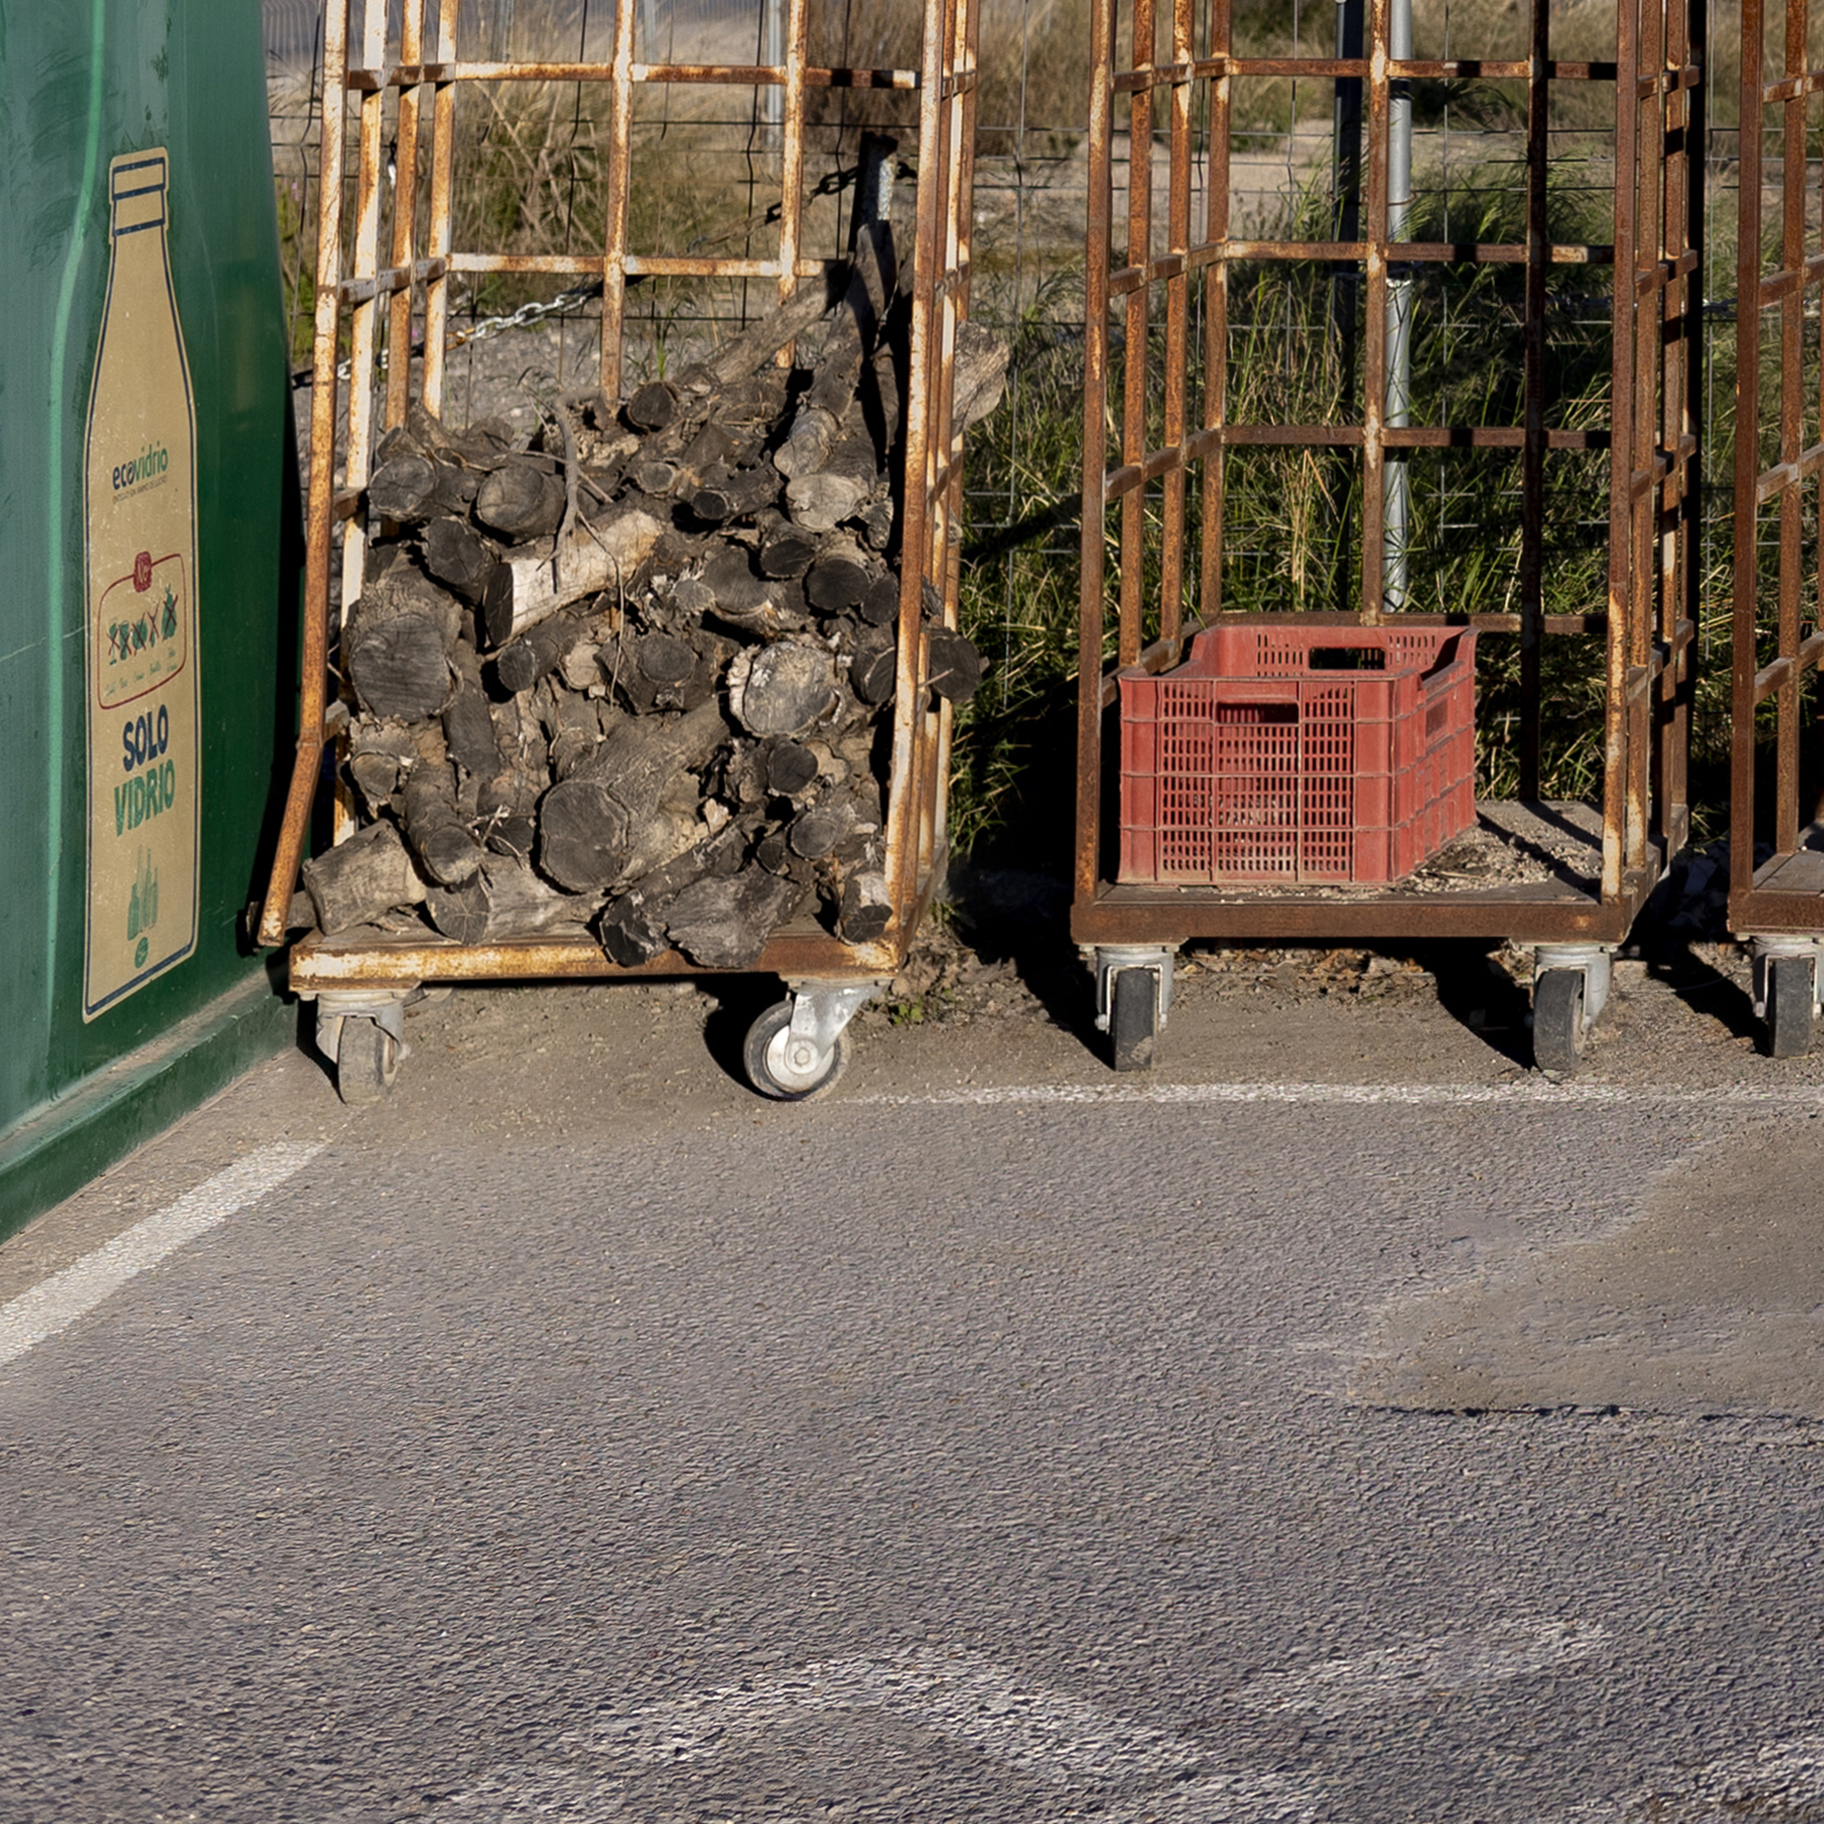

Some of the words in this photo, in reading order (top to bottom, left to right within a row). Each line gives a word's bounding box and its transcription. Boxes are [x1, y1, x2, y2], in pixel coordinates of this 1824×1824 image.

[112, 440, 169, 490] ecovidrio
[123, 704, 169, 772] SOLO
[113, 758, 176, 837] VIDRIO
